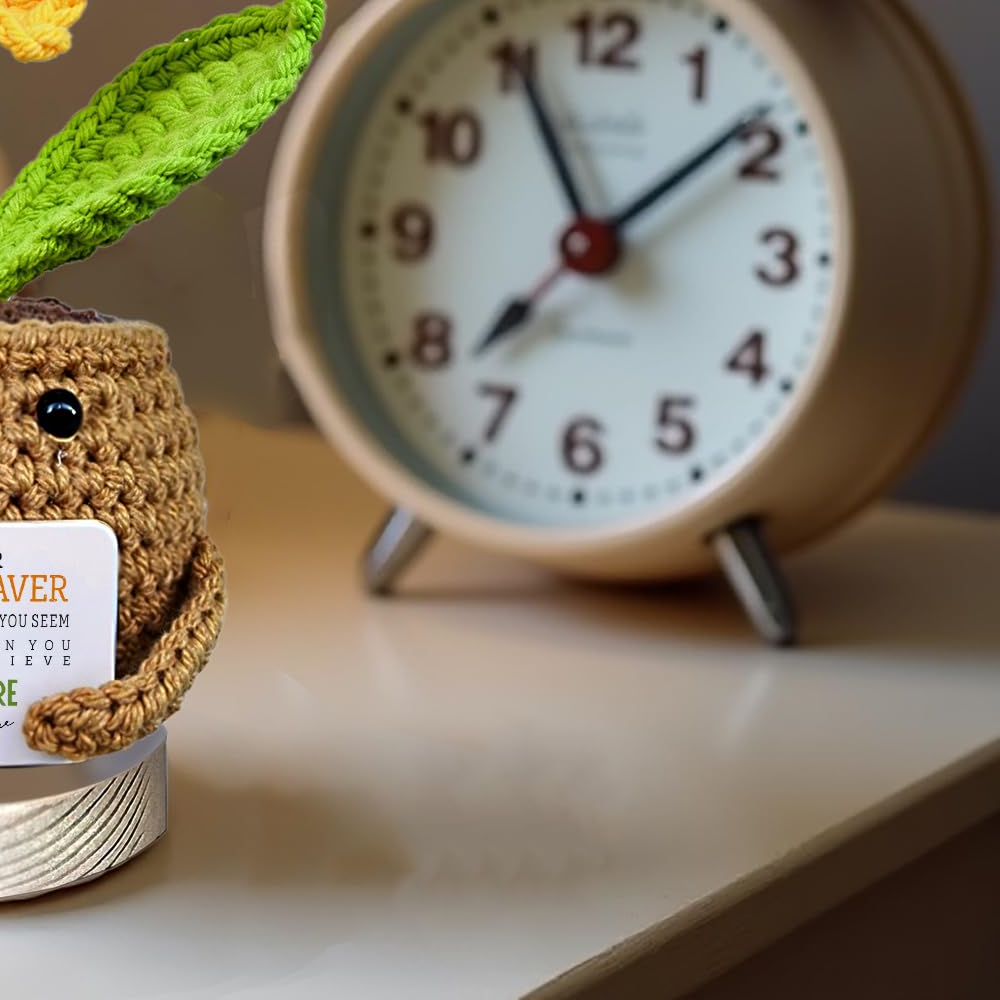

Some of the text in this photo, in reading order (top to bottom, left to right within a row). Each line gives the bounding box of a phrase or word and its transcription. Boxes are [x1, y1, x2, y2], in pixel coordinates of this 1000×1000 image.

[567, 10, 640, 69] 12
[682, 49, 710, 102] 1
[420, 110, 482, 167] 10
[736, 124, 783, 180] 2
[391, 206, 434, 263] 9
[755, 229, 799, 287] 3
[411, 313, 453, 369] 8
[724, 330, 770, 384] 4
[480, 383, 519, 442] 7
[655, 396, 695, 455] 5
[561, 416, 606, 473] 6
[29, 640, 71, 651] YOU
[31, 614, 70, 628] SEEM
